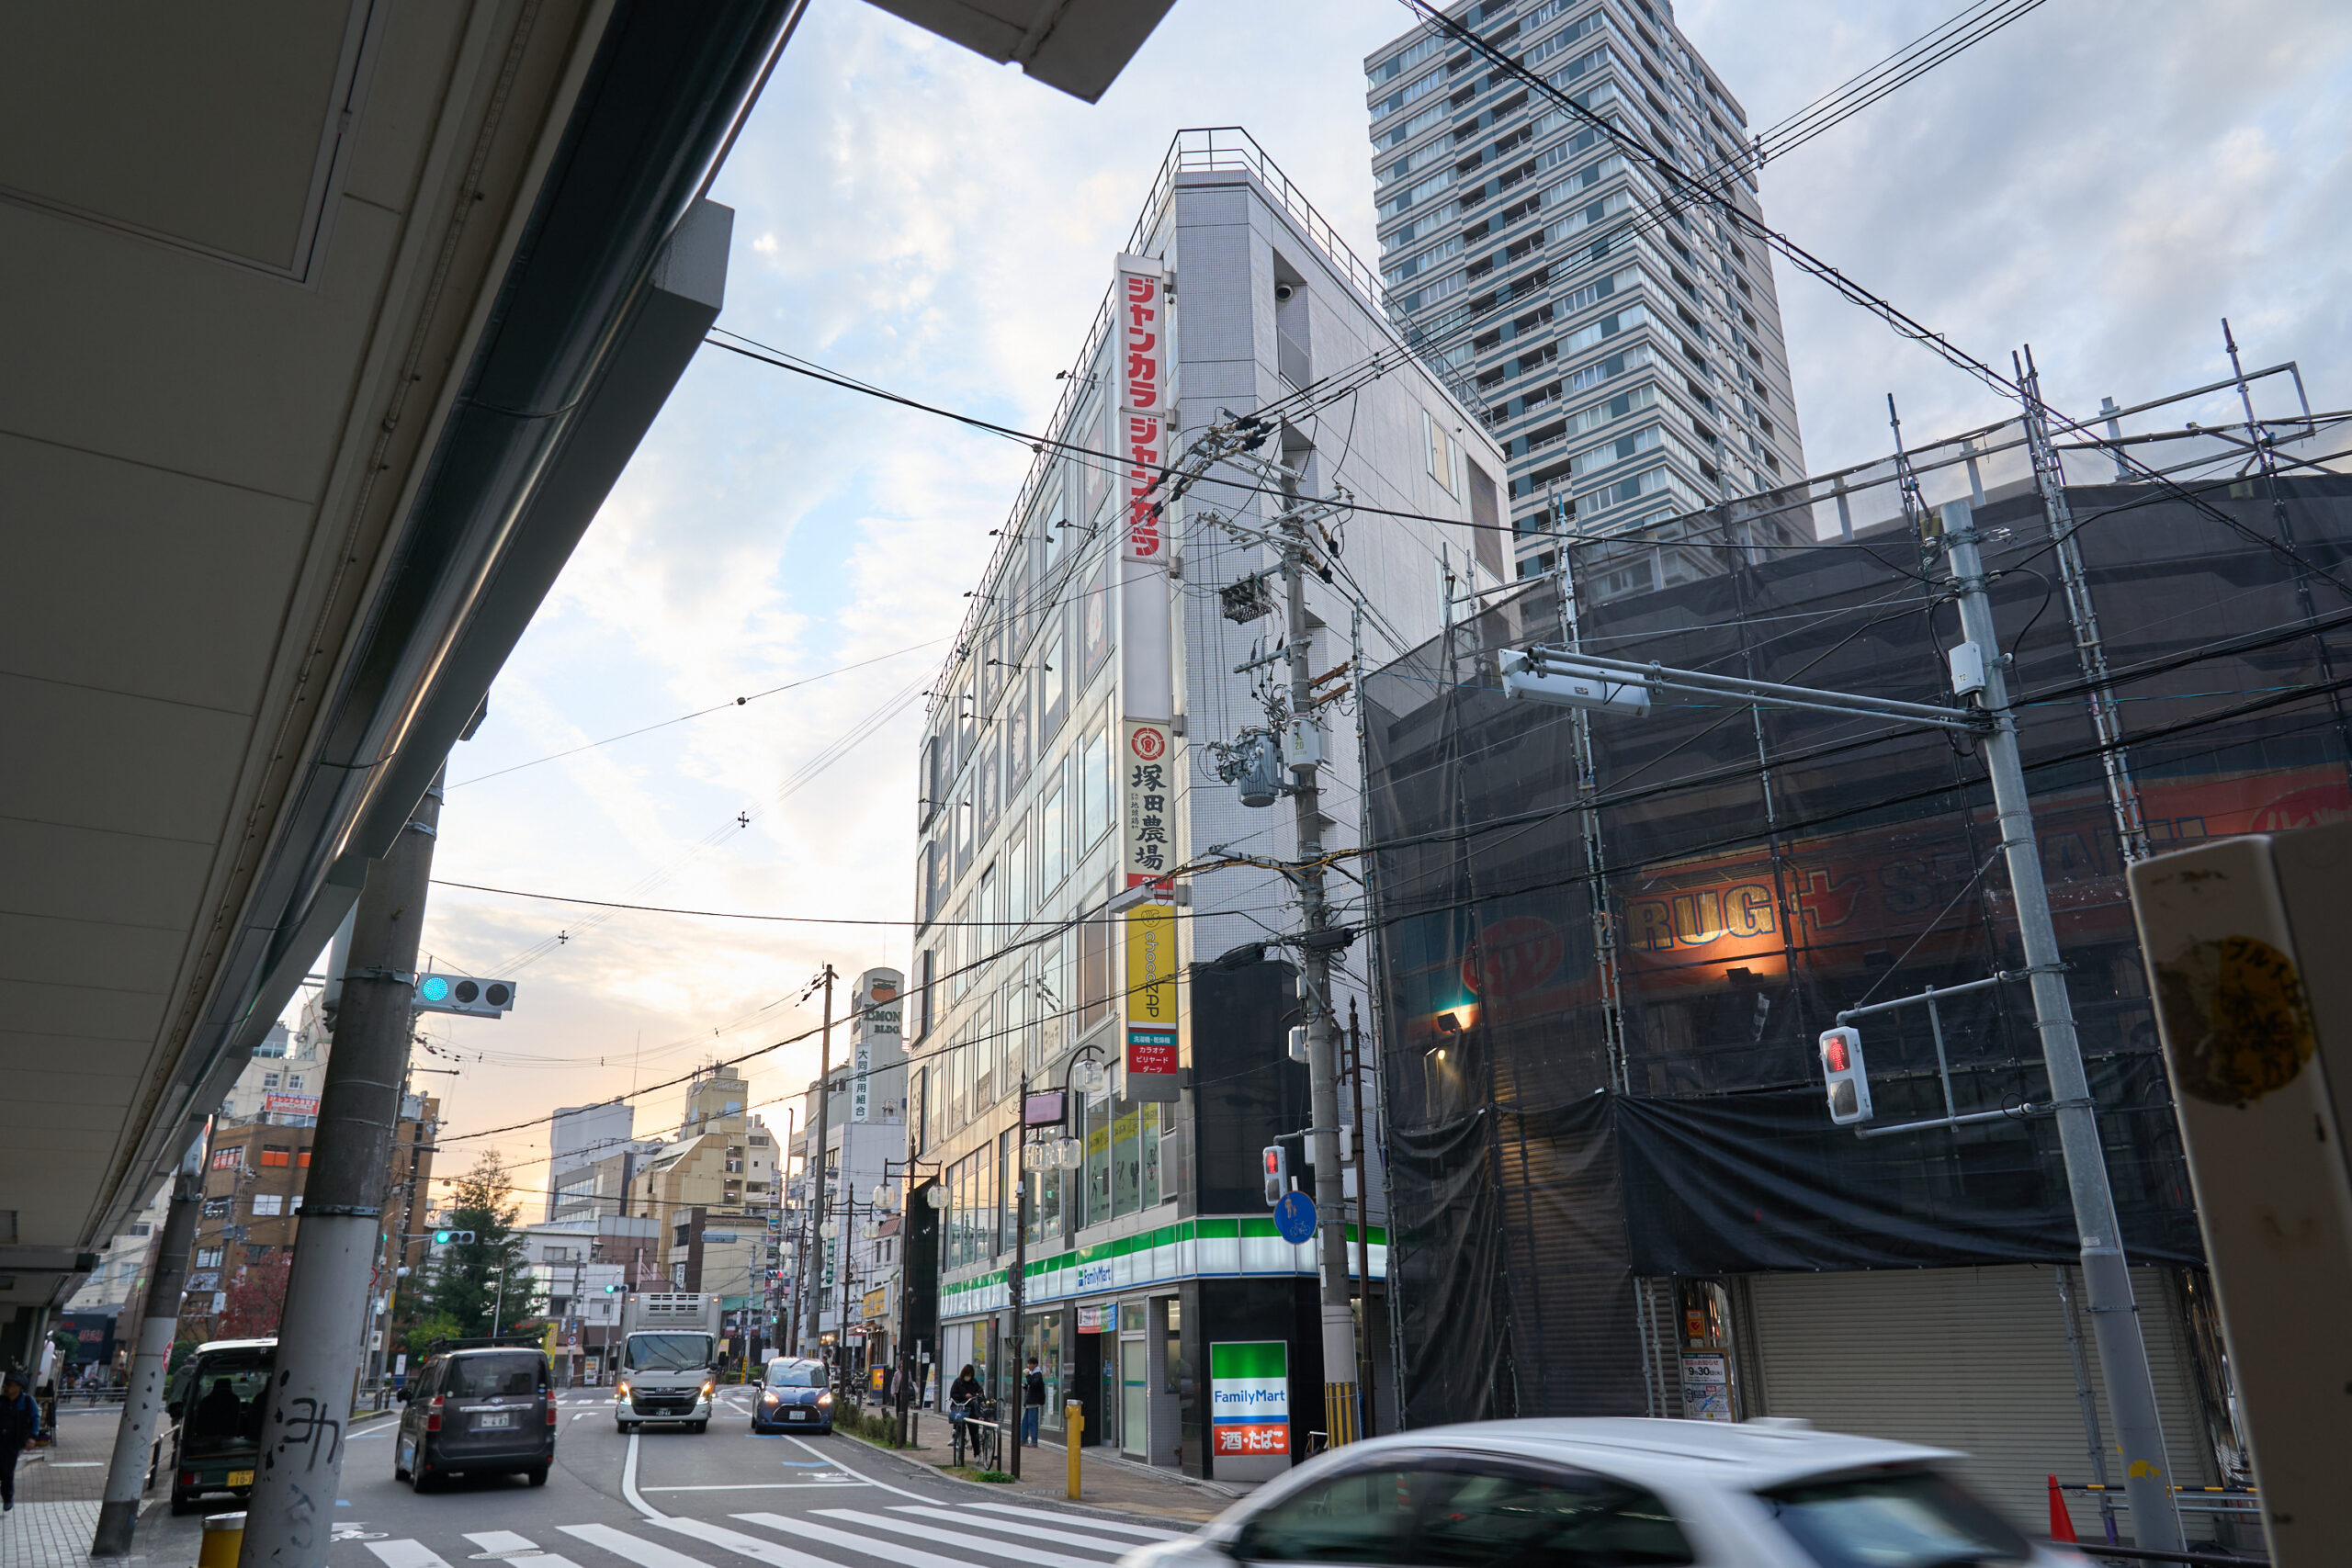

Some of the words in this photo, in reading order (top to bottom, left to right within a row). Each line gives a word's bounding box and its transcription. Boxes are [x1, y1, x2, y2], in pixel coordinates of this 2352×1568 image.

[1128, 277, 1157, 408] ジャンカラ
[1130, 417, 1159, 557] ジャンカラ
[1131, 763, 1169, 871] 塚田農場
[1601, 882, 1777, 957] RUG
[1145, 931, 1159, 1018] chocoZAP
[1136, 1055, 1169, 1065] ビリヤード
[1139, 1046, 1166, 1055] カラオケ
[1084, 1265, 1111, 1286] FamilyMart
[1214, 1389, 1285, 1405] FamilyMart
[1220, 1429, 1284, 1450] 酒・たばこ
